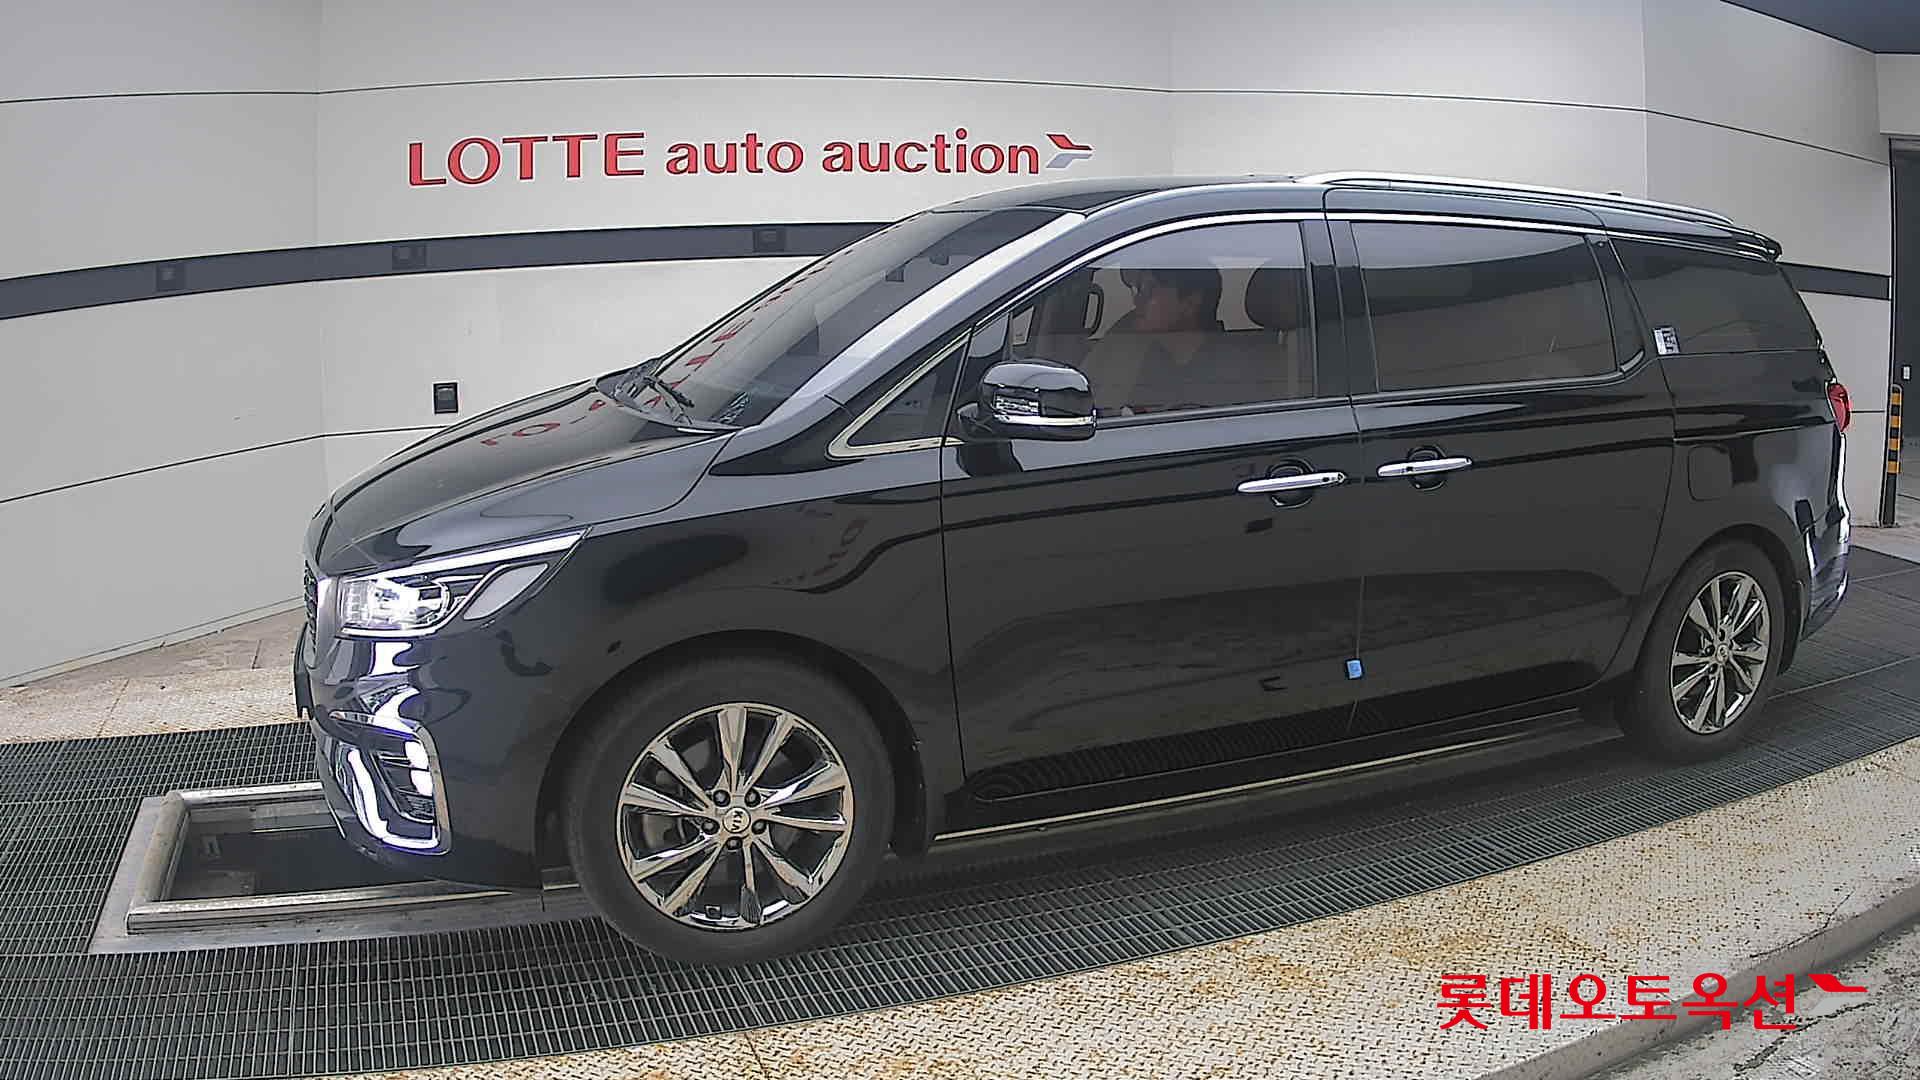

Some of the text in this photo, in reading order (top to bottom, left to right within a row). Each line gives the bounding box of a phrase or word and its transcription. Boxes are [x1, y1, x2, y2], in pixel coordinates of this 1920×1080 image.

[408, 128, 1040, 186] LOTTE auto auction
[731, 810, 744, 831] KIA
